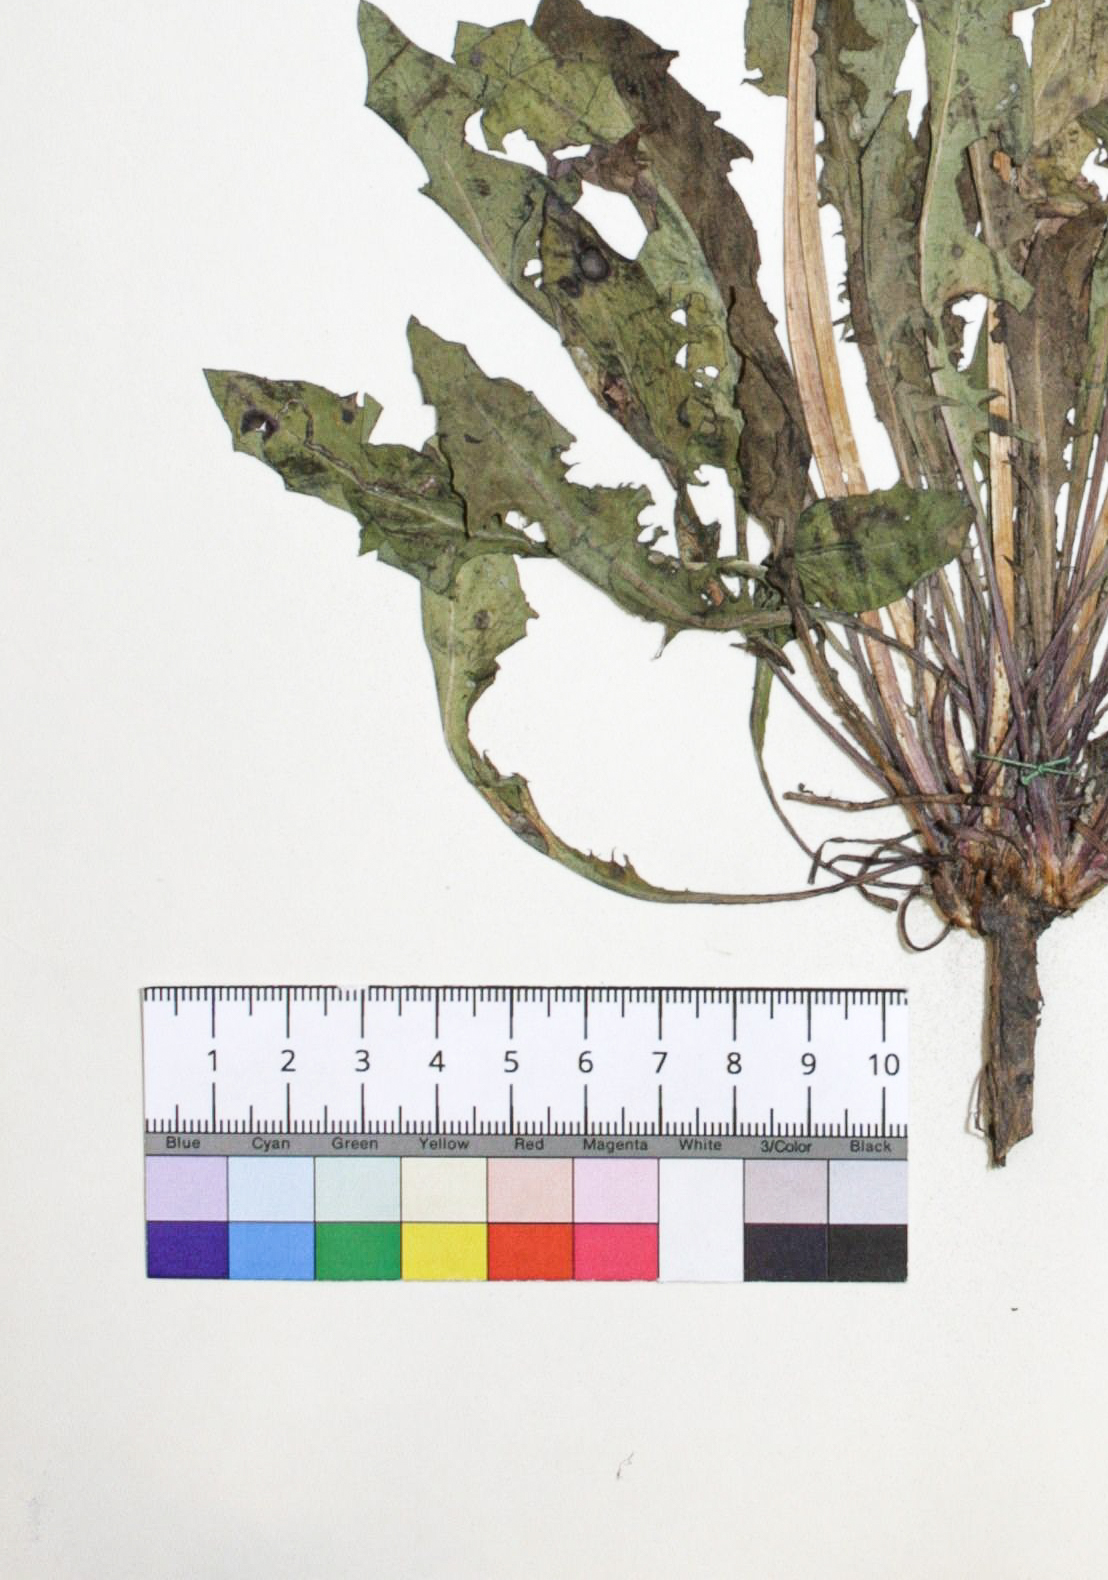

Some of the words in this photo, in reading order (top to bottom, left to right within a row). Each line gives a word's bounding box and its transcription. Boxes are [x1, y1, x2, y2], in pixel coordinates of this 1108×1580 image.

[208, 1050, 217, 1072] 1
[281, 1050, 296, 1072] 2
[355, 1050, 370, 1072] 3
[429, 1050, 446, 1072] 4
[504, 1050, 519, 1072] 5
[578, 1052, 593, 1073] 6
[653, 1052, 667, 1073] 7
[727, 1052, 742, 1074] 8
[801, 1053, 816, 1075] 9
[868, 1054, 900, 1075] 10
[166, 1137, 200, 1149] Blue
[252, 1137, 290, 1151] Cyan
[332, 1138, 378, 1150] Green
[419, 1138, 470, 1150] Yellow
[515, 1138, 544, 1150] Red
[583, 1139, 648, 1153] Magenta
[679, 1139, 722, 1151] White
[760, 1140, 812, 1153] 3/Color
[850, 1140, 892, 1153] Black
